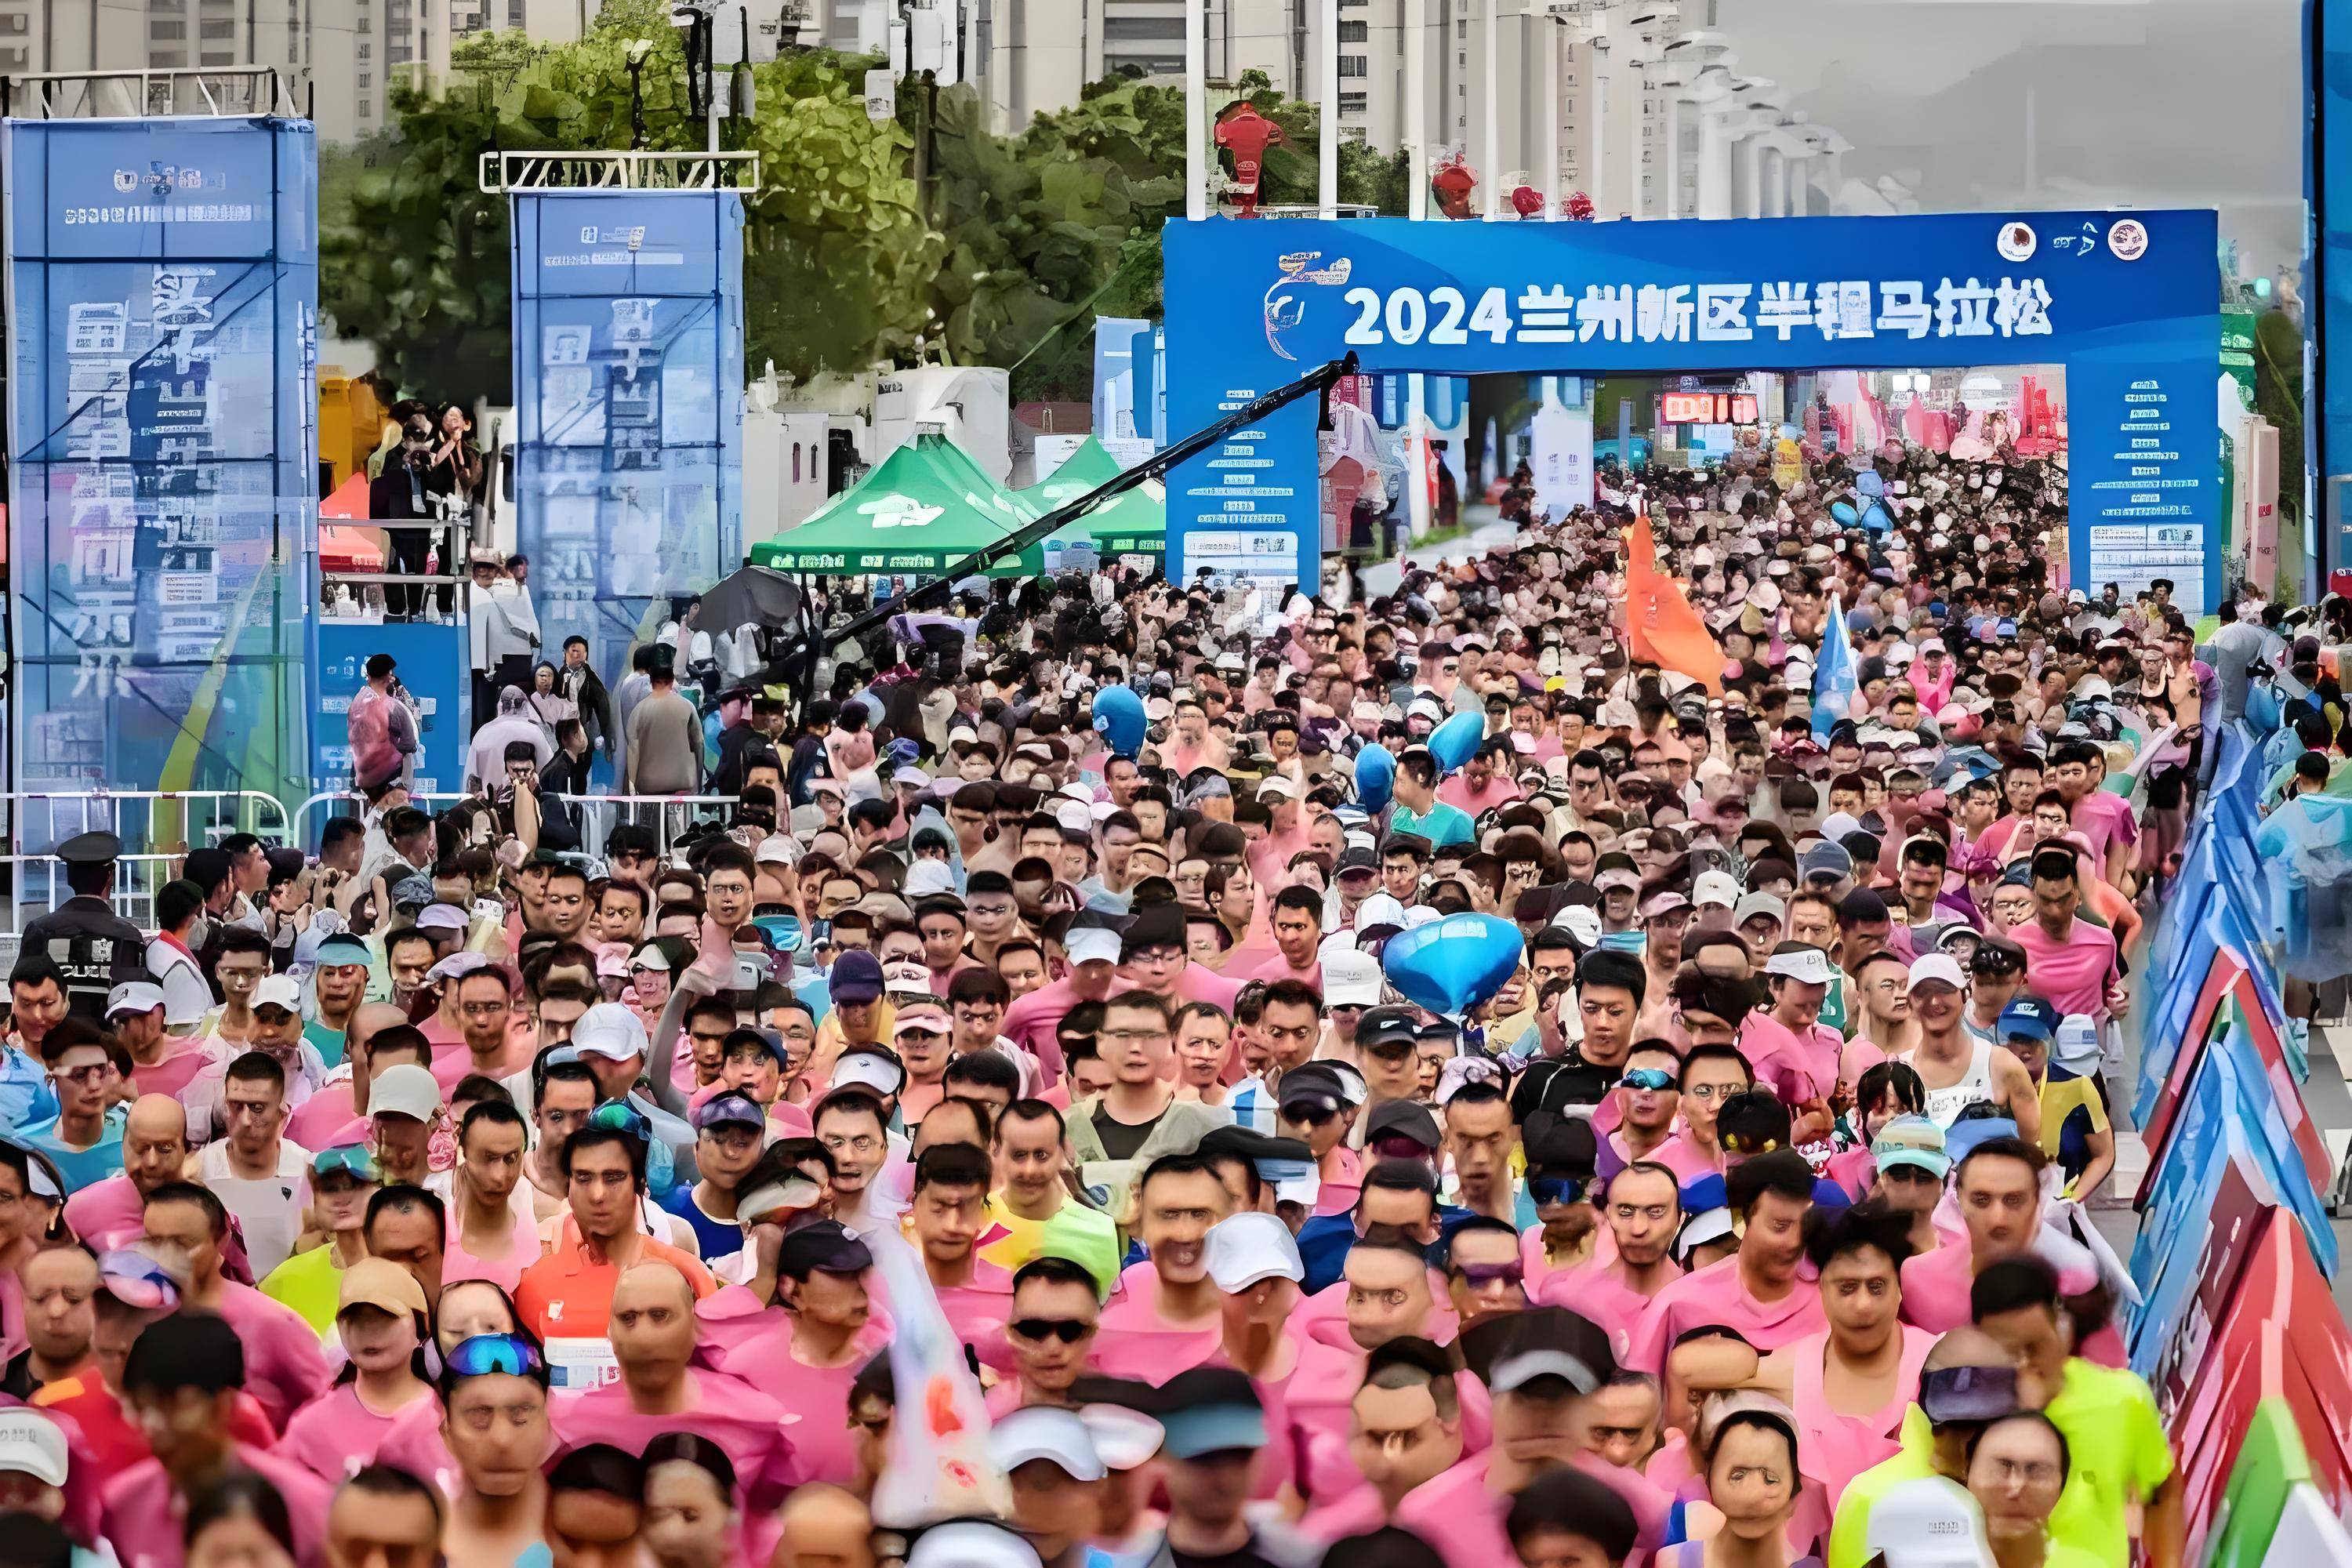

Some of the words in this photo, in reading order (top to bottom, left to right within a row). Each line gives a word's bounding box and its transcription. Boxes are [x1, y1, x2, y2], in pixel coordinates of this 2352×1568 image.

[1344, 278, 2053, 344] 2024兰州新区半程马拉松
